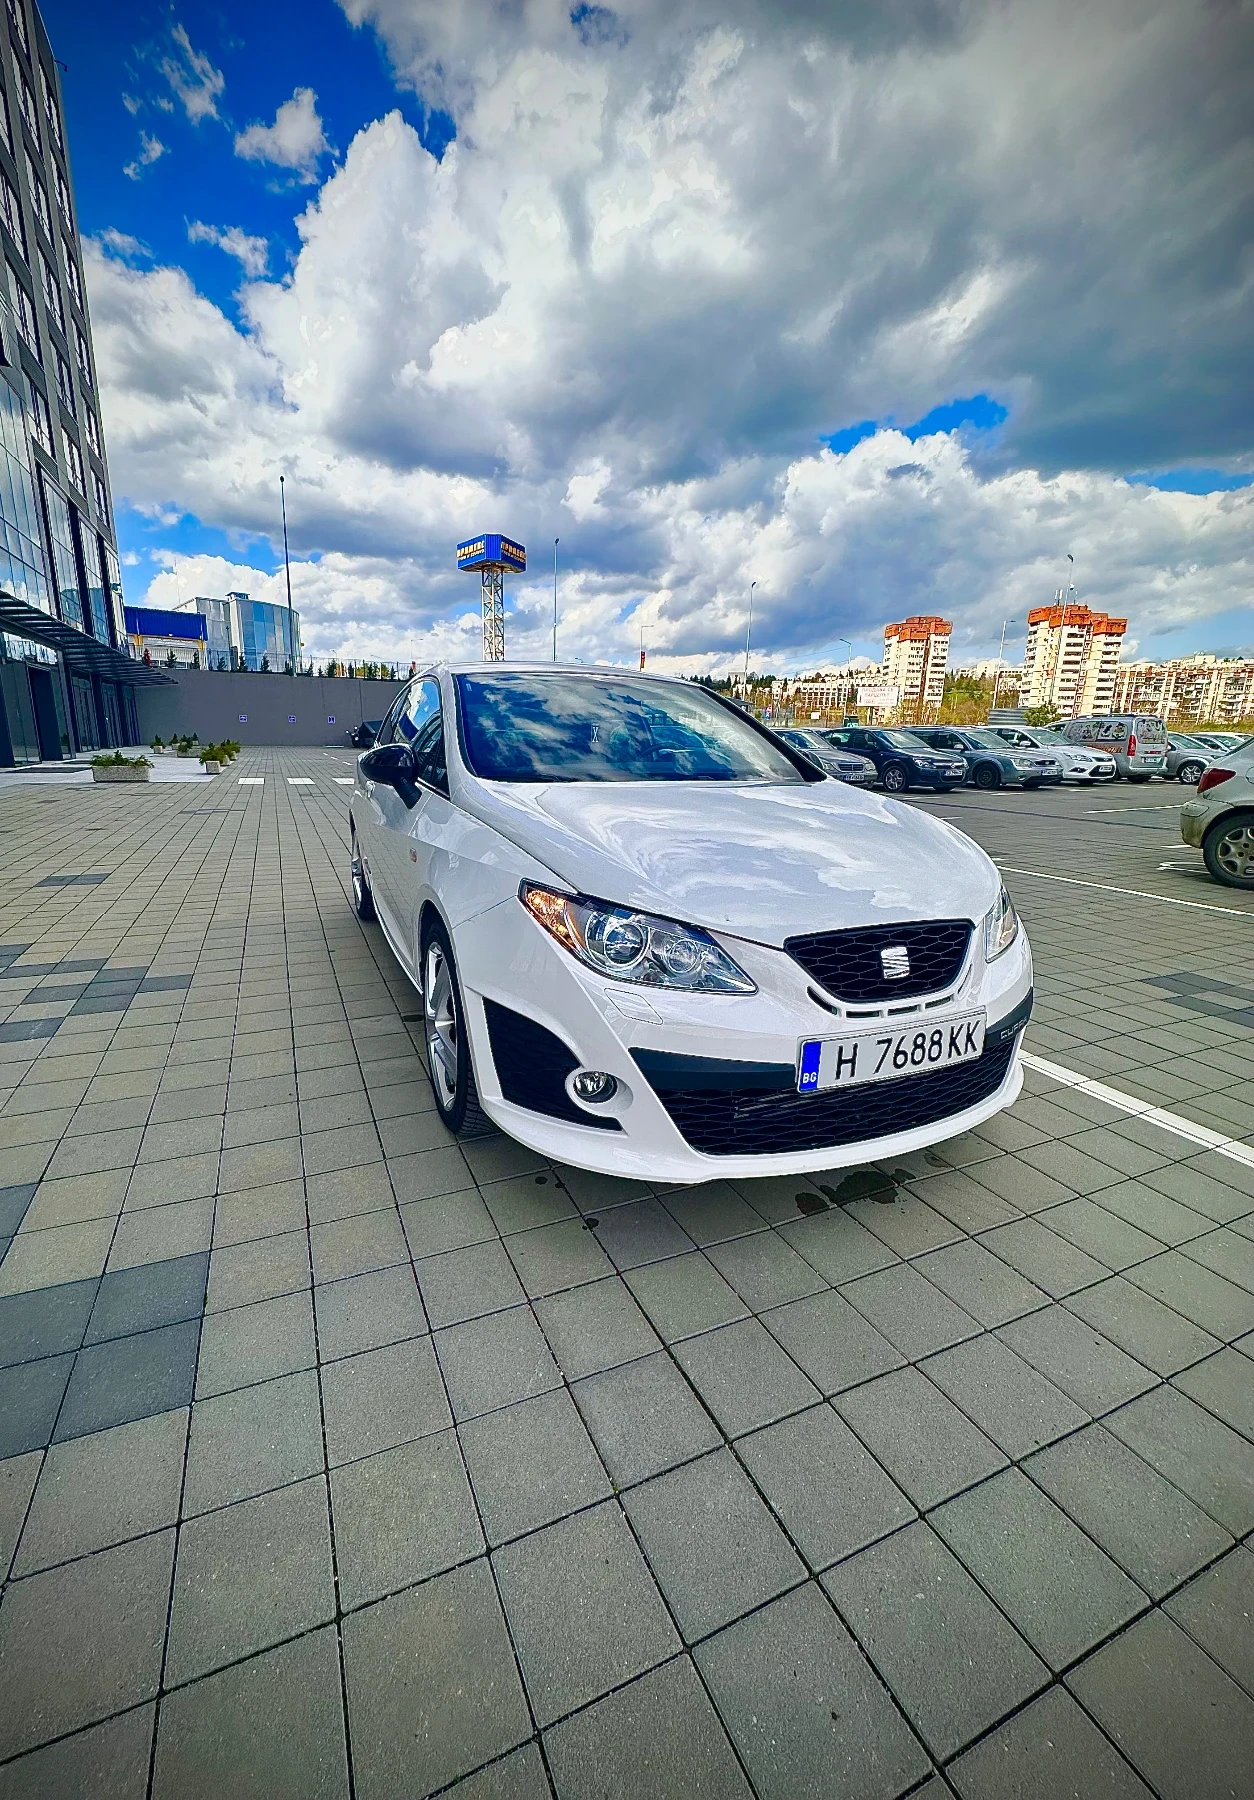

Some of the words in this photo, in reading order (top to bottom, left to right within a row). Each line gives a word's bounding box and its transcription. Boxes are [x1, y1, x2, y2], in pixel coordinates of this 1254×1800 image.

[835, 1042, 859, 1080] H
[873, 1019, 981, 1075] 7688KK
[803, 1071, 817, 1083] BG
